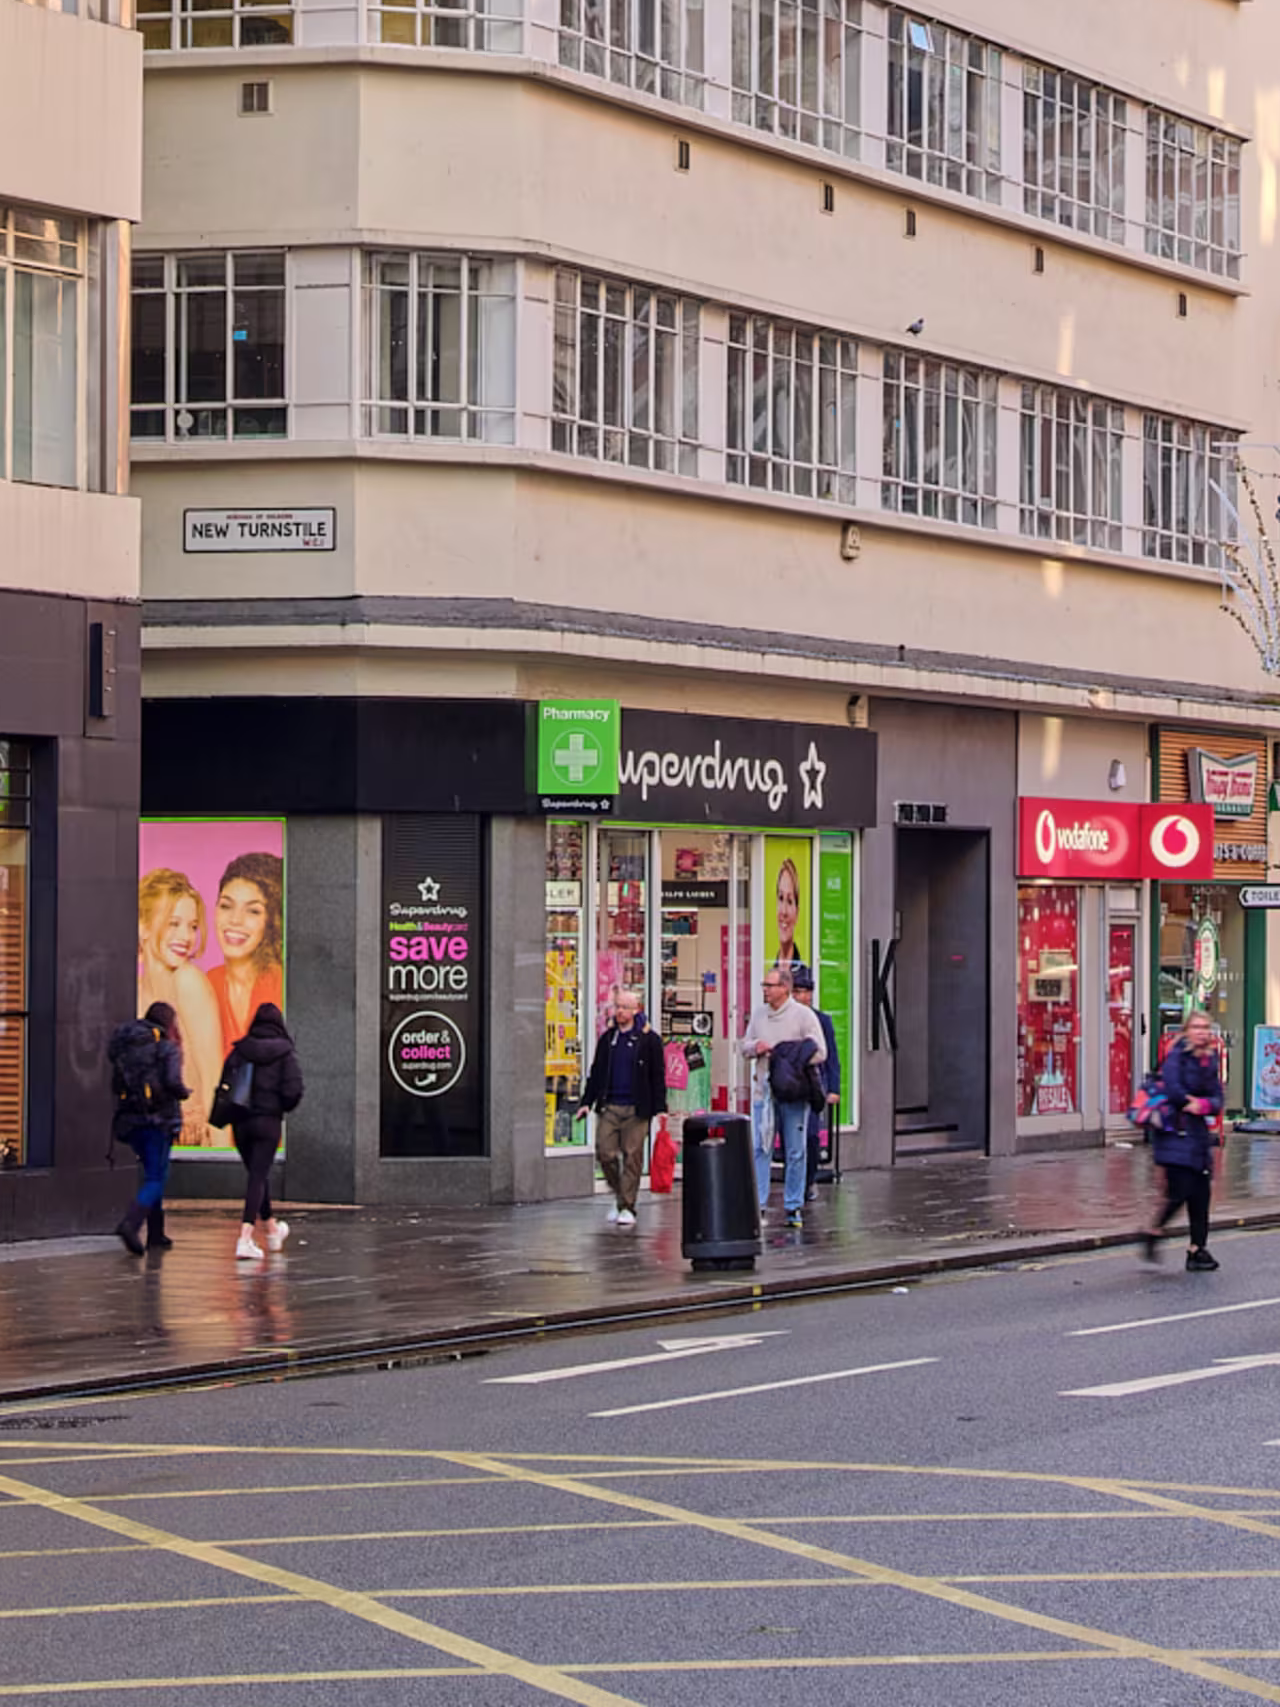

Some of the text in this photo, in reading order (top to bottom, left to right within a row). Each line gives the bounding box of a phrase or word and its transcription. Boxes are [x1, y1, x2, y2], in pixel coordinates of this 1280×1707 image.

[192, 521, 327, 539] NEW TURNSTILE
[543, 707, 611, 723] Pharmacy
[617, 739, 788, 812] uperdrug
[541, 799, 599, 811] Superdrug
[1056, 821, 1110, 852] vodafone
[389, 902, 468, 919] Superdrug
[389, 936, 468, 962] save
[389, 964, 468, 990] more
[869, 938, 898, 1052] K
[401, 1029, 440, 1044] order
[401, 1044, 451, 1060] collect
